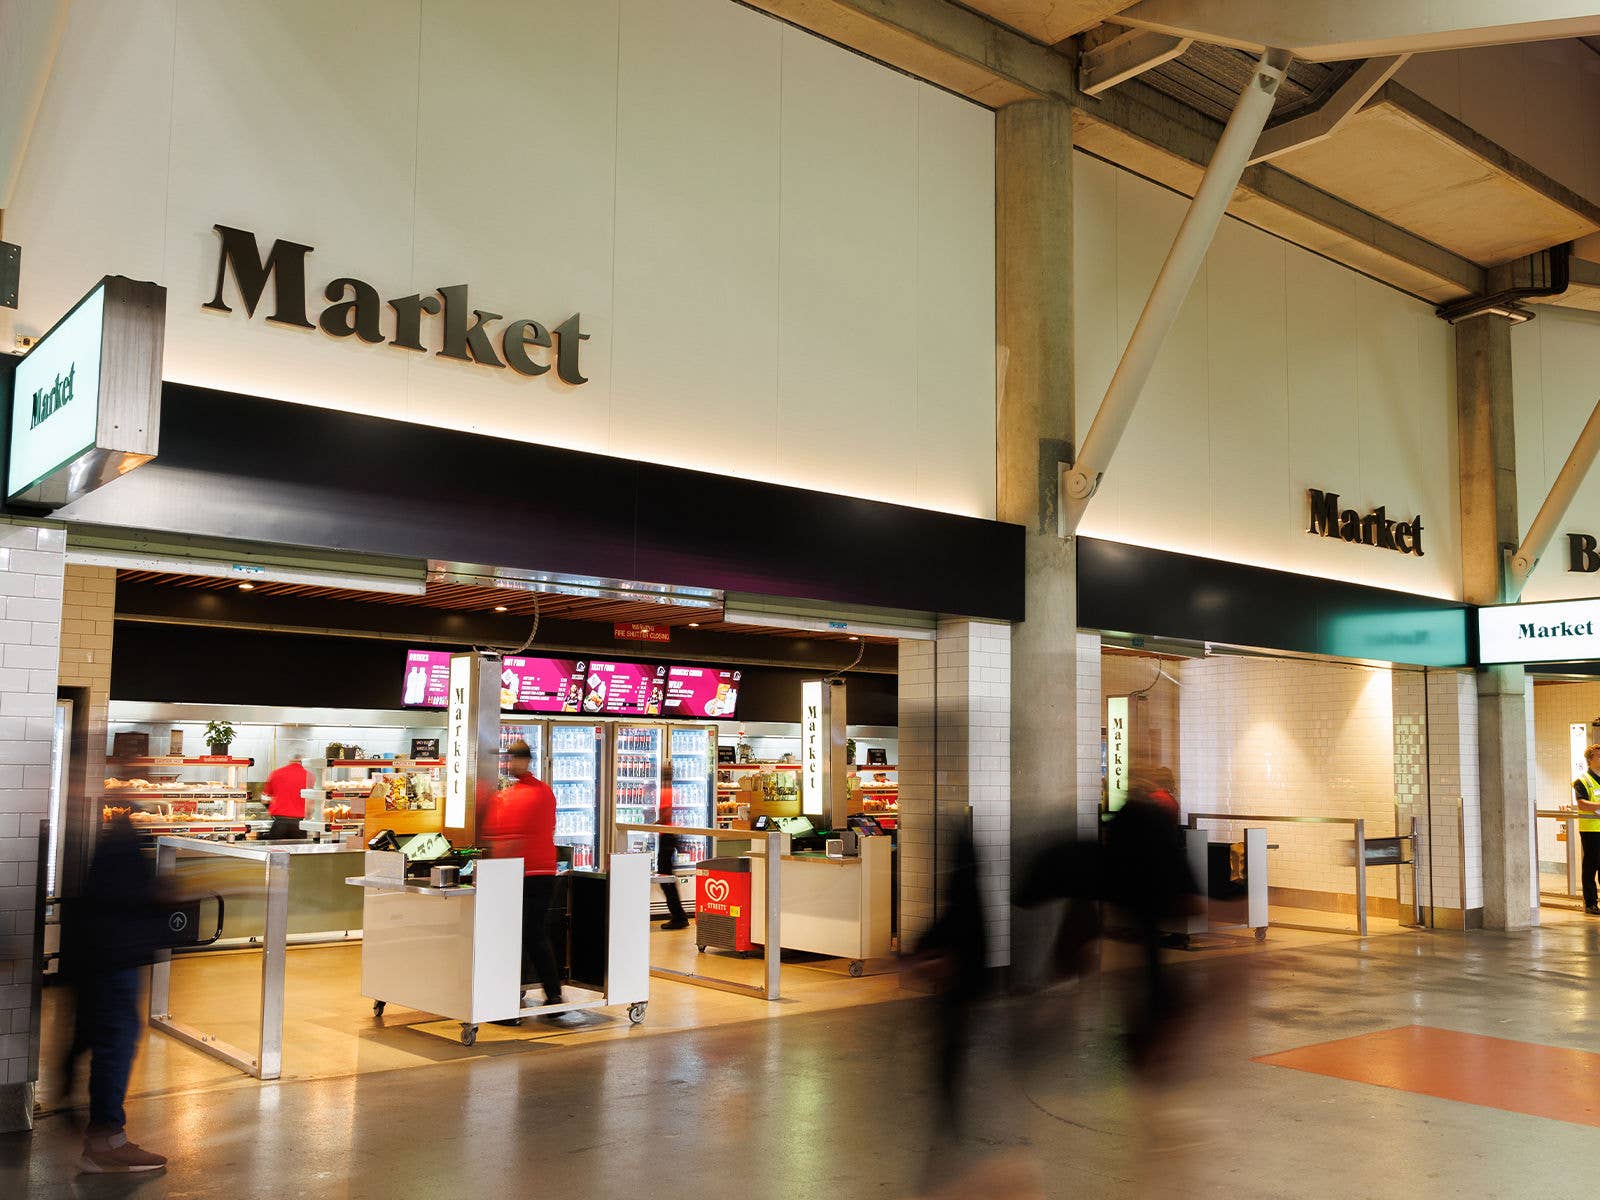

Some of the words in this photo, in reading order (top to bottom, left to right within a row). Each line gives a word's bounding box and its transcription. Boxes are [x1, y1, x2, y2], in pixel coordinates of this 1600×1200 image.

[201, 223, 591, 386] Market
[30, 361, 76, 431] Market
[1306, 488, 1425, 557] Market
[1566, 533, 1600, 573] B
[614, 629, 626, 637] FIRE
[626, 630, 649, 638] SHUTTER
[649, 632, 670, 640] CLOSING
[1518, 620, 1595, 640] Market
[453, 688, 466, 795] Market
[807, 705, 817, 789] Market
[1113, 718, 1123, 790] Market
[706, 902, 727, 911] STREETS
